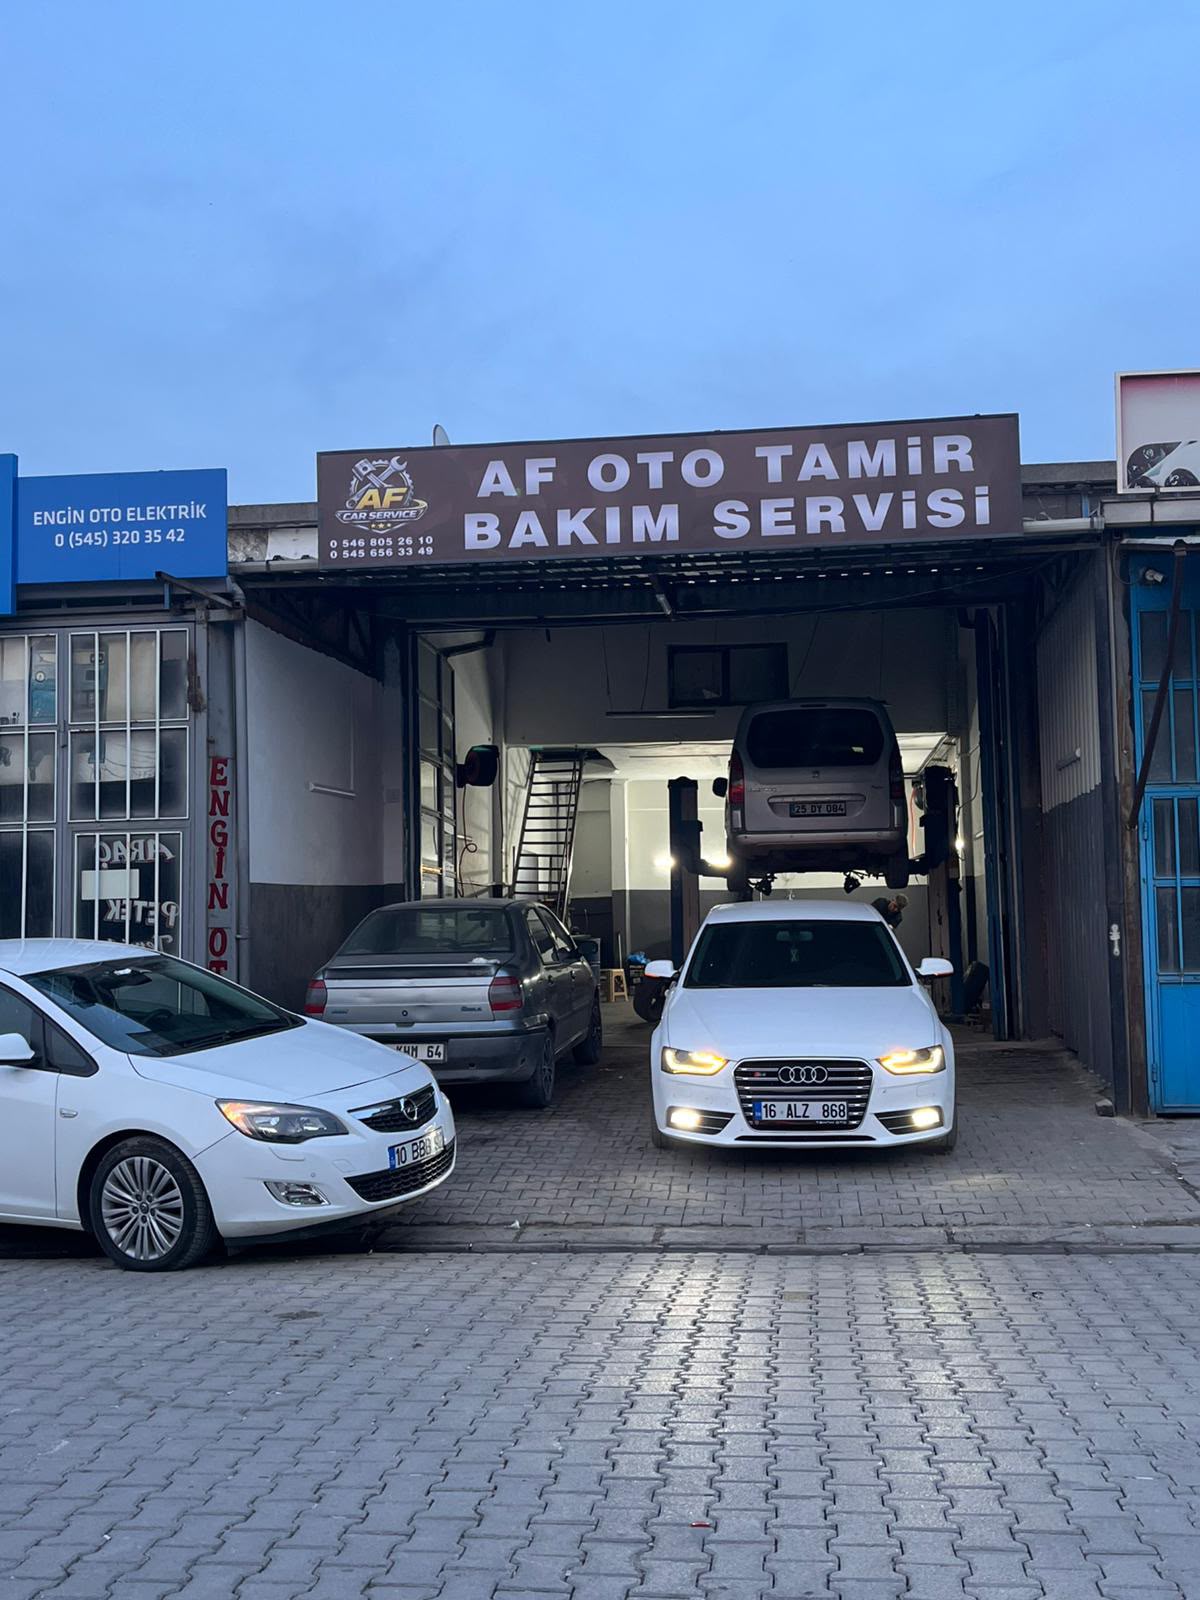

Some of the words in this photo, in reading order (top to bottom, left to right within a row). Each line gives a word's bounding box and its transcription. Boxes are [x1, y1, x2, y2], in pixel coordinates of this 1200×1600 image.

[477, 457, 556, 498] AF
[587, 449, 725, 494] OTO
[354, 487, 408, 510] AF
[33, 507, 85, 525] ENGİN
[89, 508, 122, 523] OTO
[126, 501, 207, 522] ELEKTRİK
[342, 511, 368, 521] CAR
[368, 510, 418, 520] SERVICE
[464, 503, 680, 550] BAKIM
[55, 533, 64, 547] 0
[68, 530, 108, 548] (545)
[113, 531, 140, 544] 320
[144, 529, 162, 543] 35
[166, 528, 185, 542] 42
[329, 540, 338, 548] 0
[342, 539, 365, 548] 546
[370, 537, 393, 547] 805
[397, 536, 413, 545] 26
[418, 536, 433, 545] 10
[329, 550, 338, 559] 0
[342, 549, 365, 559] 545
[397, 547, 413, 556] 33
[418, 546, 433, 555] 49
[427, 1045, 442, 1058] 64
[763, 1103, 777, 1119] 16
[786, 1103, 810, 1119] ALZ
[822, 1103, 846, 1119] 868
[395, 1146, 408, 1166] 10
